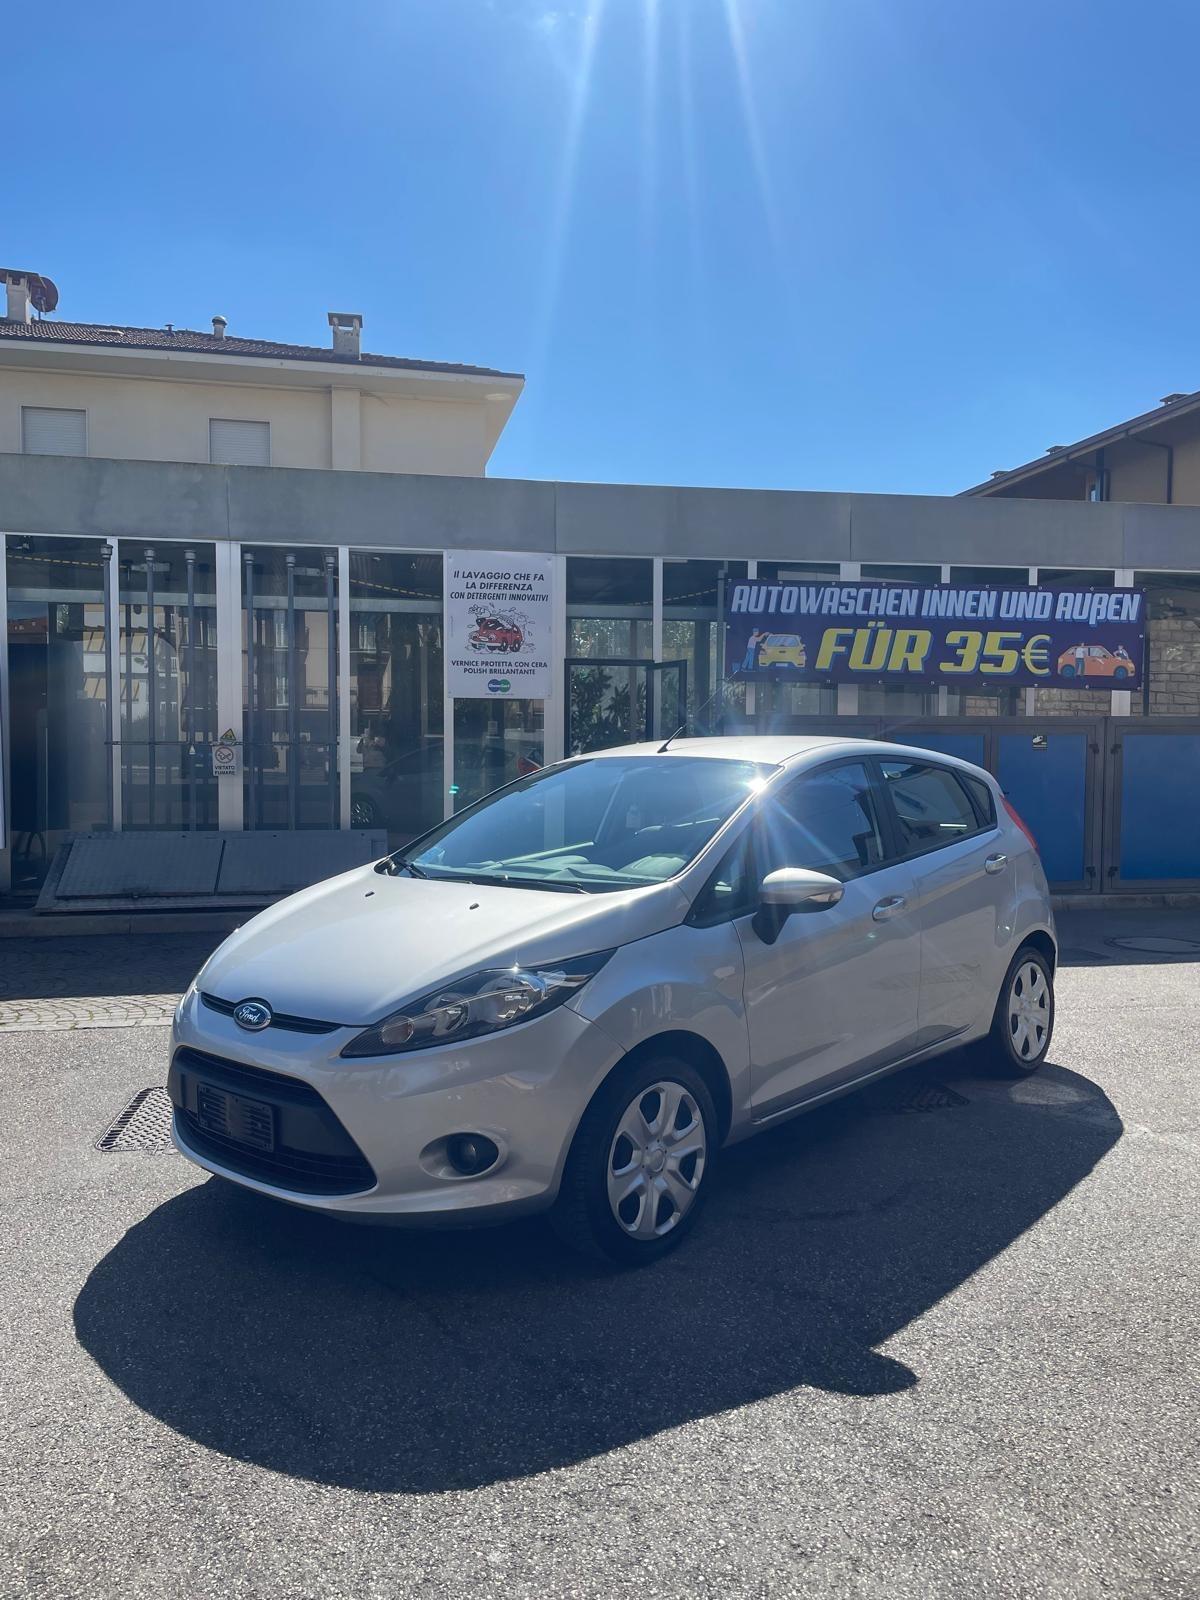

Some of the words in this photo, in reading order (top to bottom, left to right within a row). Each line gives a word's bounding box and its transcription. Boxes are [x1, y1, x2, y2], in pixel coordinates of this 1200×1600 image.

[462, 571, 511, 580] LAVAGGIO
[513, 572, 531, 581] CHE
[533, 573, 545, 582] FA
[465, 581, 477, 590] LA
[479, 582, 533, 591] DIFFERENZA
[450, 591, 466, 600] CON
[466, 592, 508, 601] DETERGENTI
[508, 593, 549, 602] INNOVATIVI
[731, 585, 919, 617] AUTOWASCHEN
[921, 589, 998, 619] INNEN
[999, 591, 1053, 621] UND
[814, 621, 933, 673] FÜR
[939, 629, 1052, 676] 35€
[480, 660, 513, 668] PROTETTA
[239, 1005, 261, 1022] Ford
